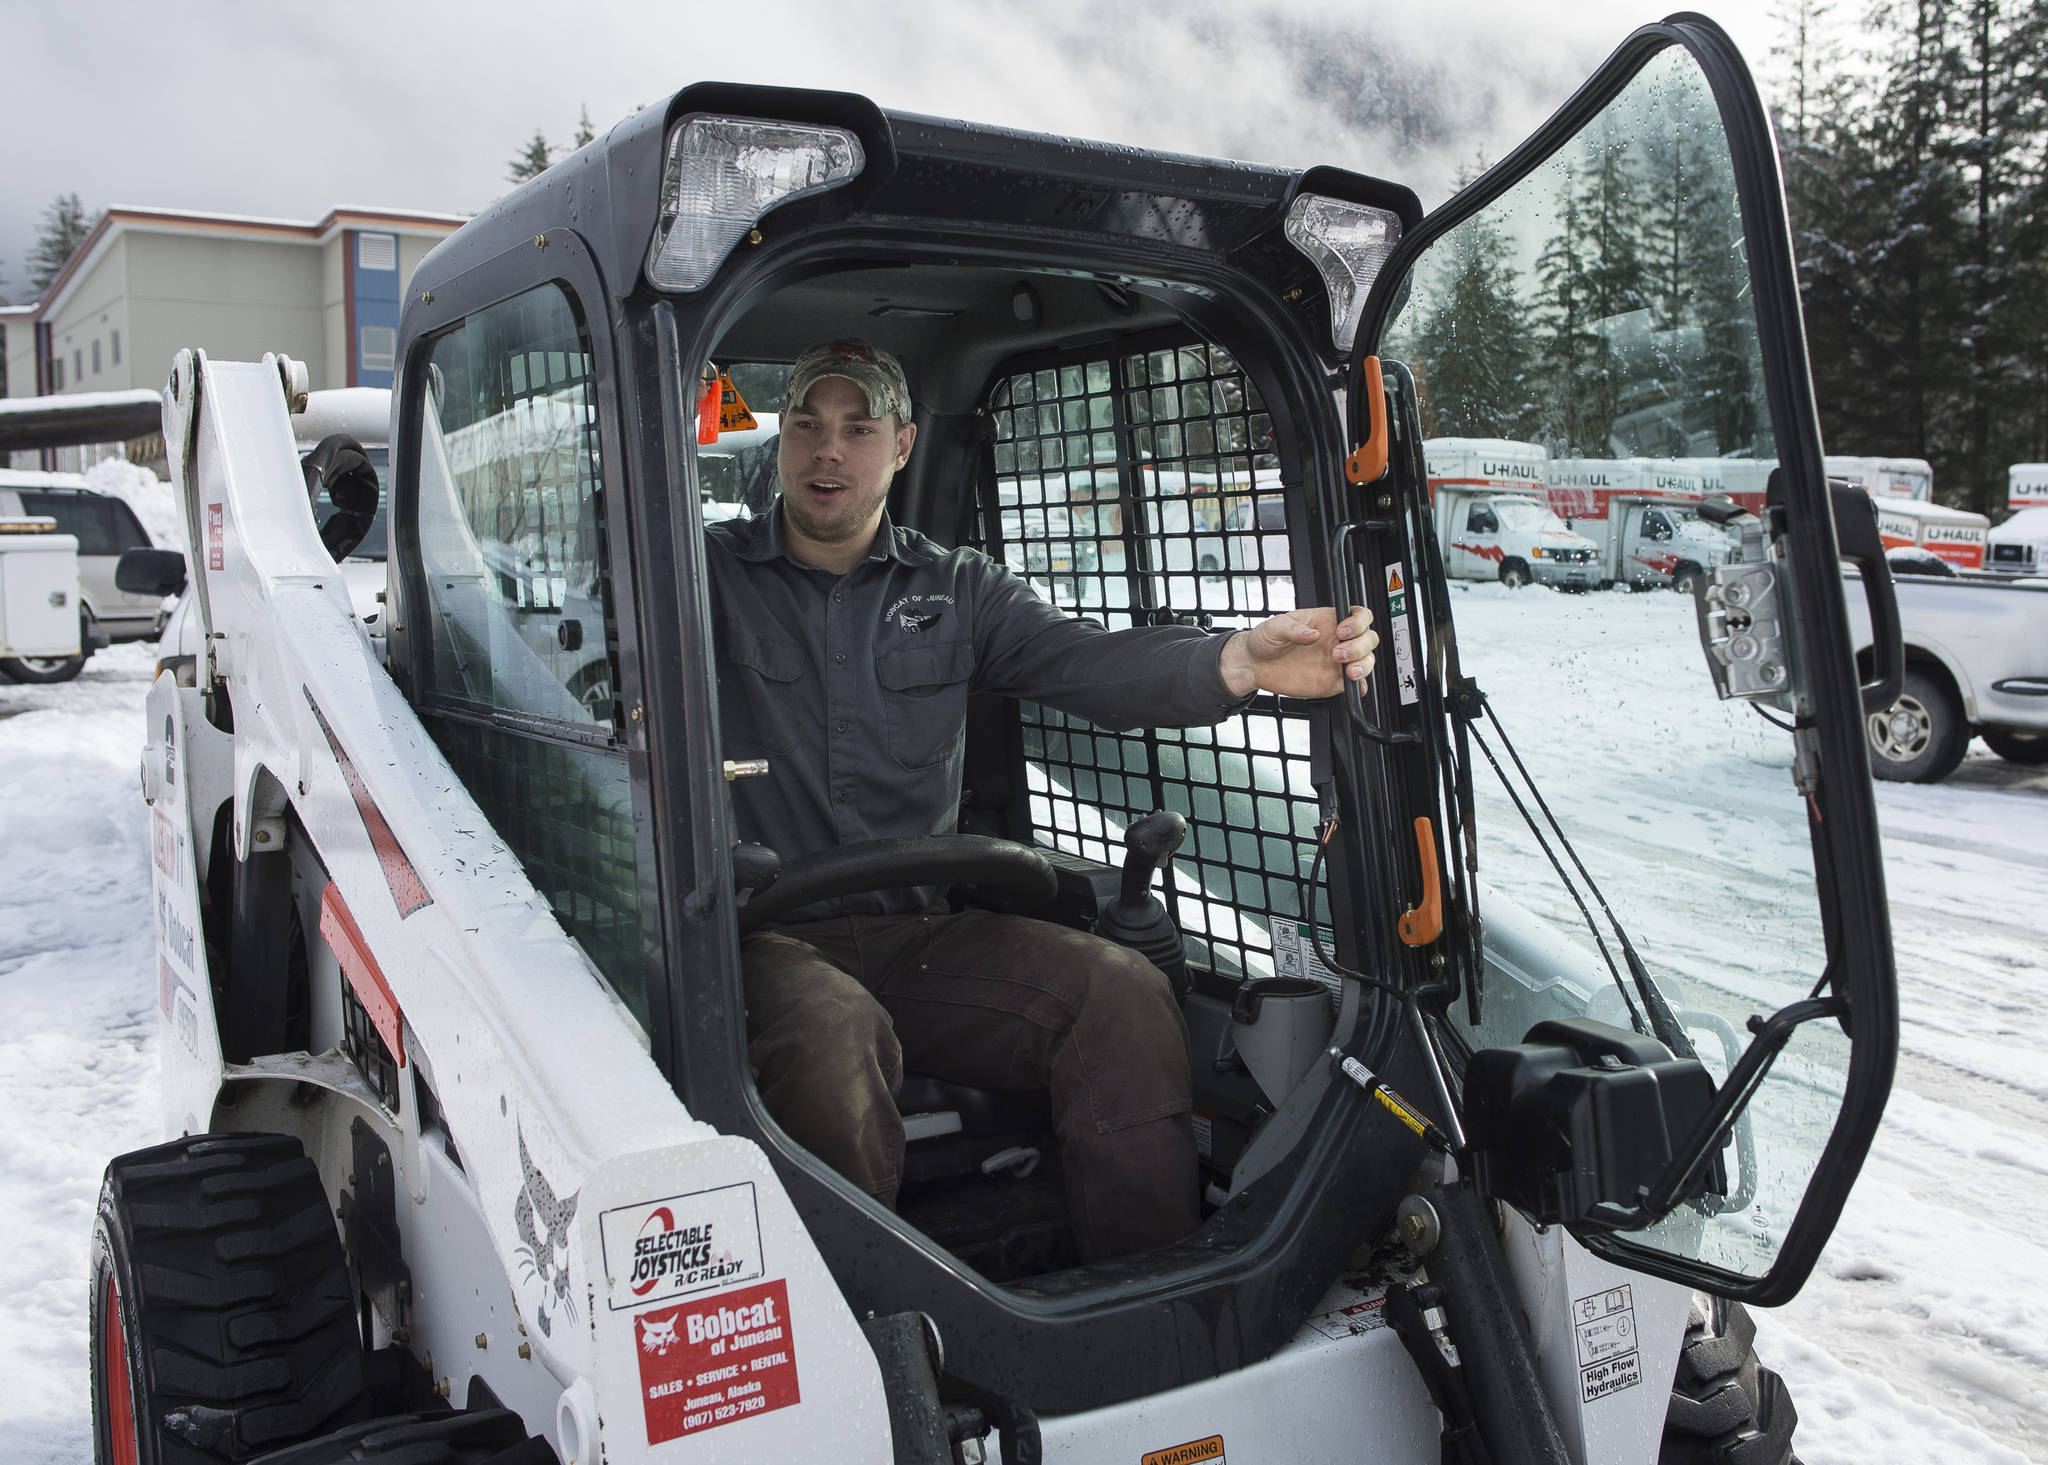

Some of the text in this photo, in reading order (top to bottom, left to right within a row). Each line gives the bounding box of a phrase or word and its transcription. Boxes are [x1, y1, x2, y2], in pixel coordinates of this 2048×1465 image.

[1483, 462, 1539, 479] U-HAUL
[1656, 476, 1697, 491] U-HAUL
[1927, 528, 1981, 541] U-HAUL
[885, 597, 909, 622] BOBCAT
[926, 594, 955, 605] JUNEAU
[634, 1224, 713, 1257] SELECTABLE
[630, 1243, 711, 1282] JOYSTICKS
[674, 1270, 698, 1287] R/C
[700, 1259, 743, 1281] READY
[686, 1296, 776, 1345] Bobcat
[710, 1326, 783, 1355] of Juneau
[649, 1352, 788, 1399] SALES SERVICE RENTAL
[1586, 1358, 1635, 1383] High Flow
[1586, 1371, 1639, 1397] Hydraulics
[683, 1381, 762, 1412] Juneau, Alaska
[1160, 1441, 1218, 1465] WARNING
